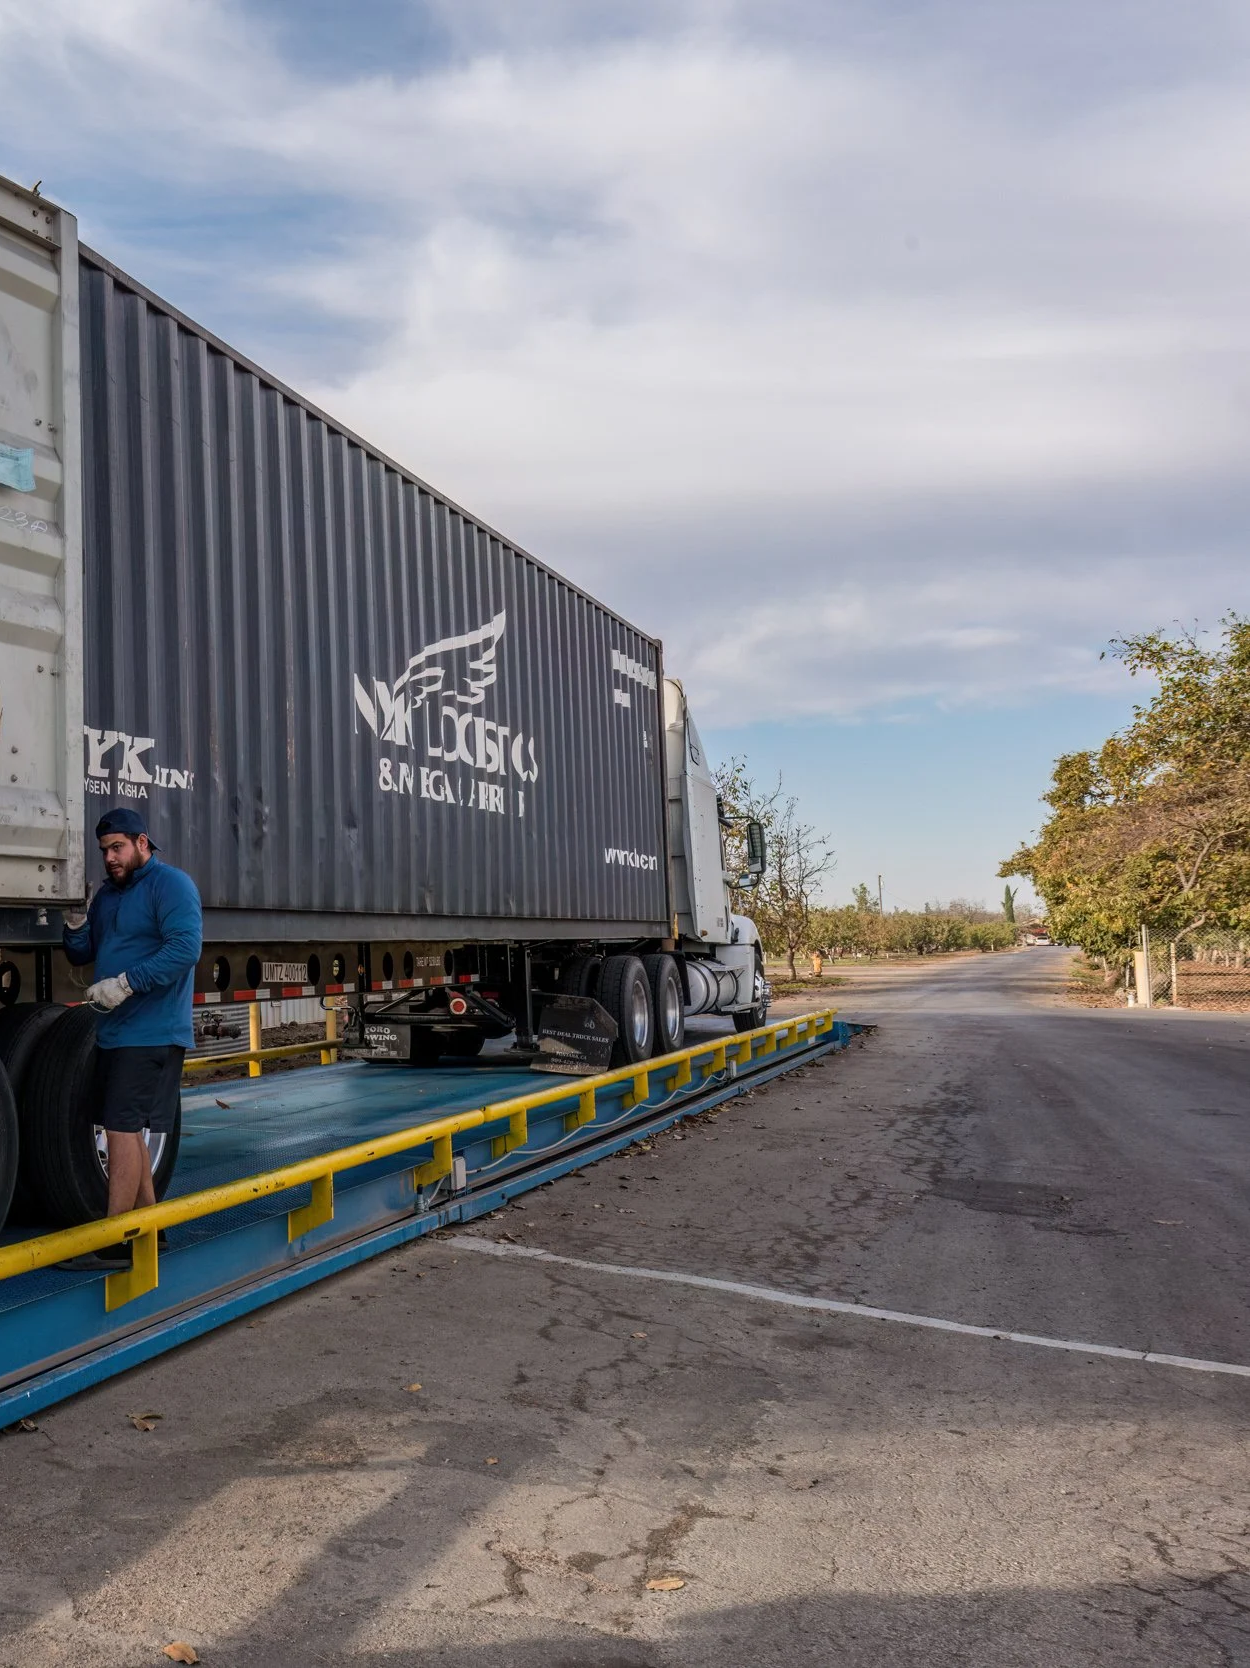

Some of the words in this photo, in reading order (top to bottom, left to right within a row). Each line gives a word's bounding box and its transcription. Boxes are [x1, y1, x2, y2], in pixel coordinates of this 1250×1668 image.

[354, 672, 415, 751] NYK
[84, 725, 155, 783] YK
[556, 1030, 572, 1038] DEAL
